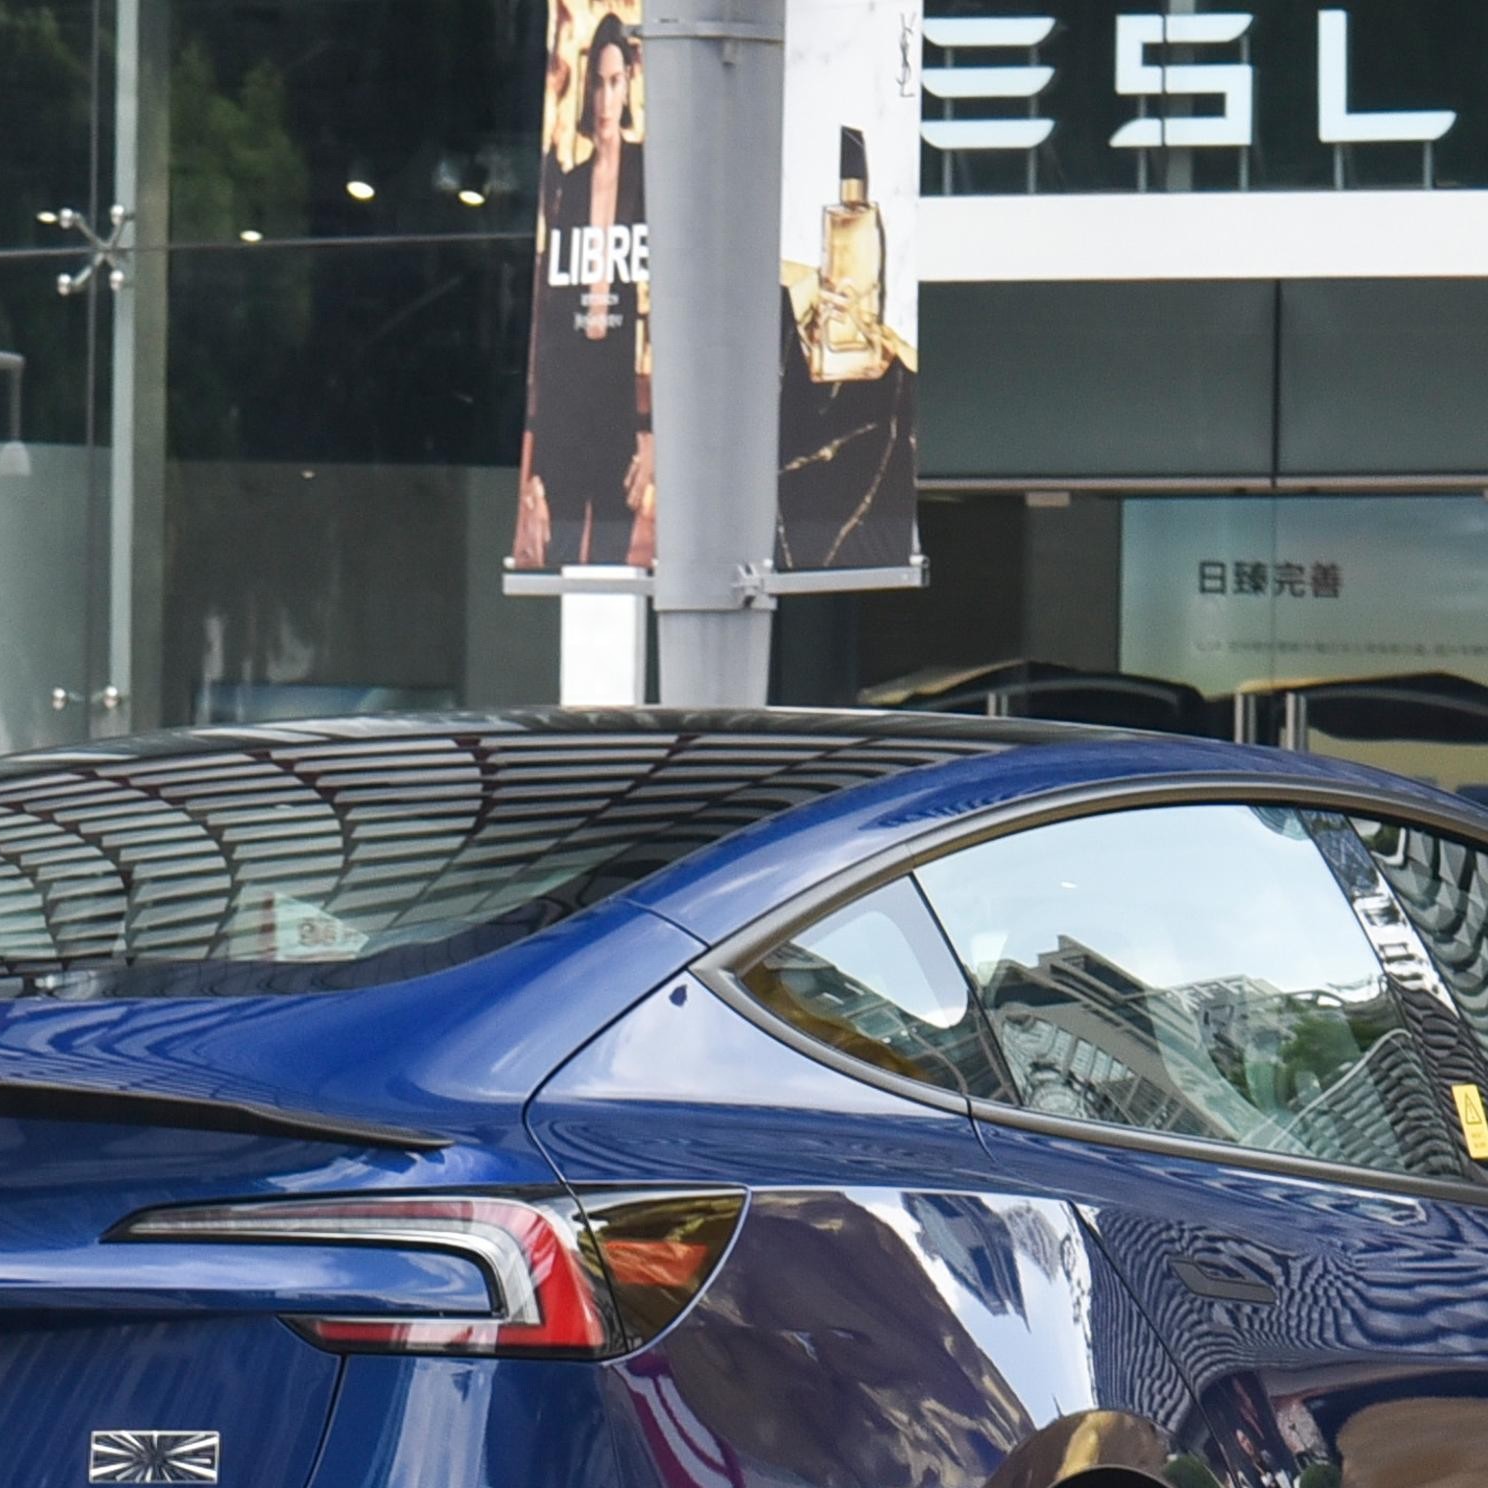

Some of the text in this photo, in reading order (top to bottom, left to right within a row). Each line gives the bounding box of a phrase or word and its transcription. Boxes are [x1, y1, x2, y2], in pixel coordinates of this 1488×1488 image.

[548, 224, 649, 286] LIBRE
[1198, 561, 1342, 598] 日臻完善
